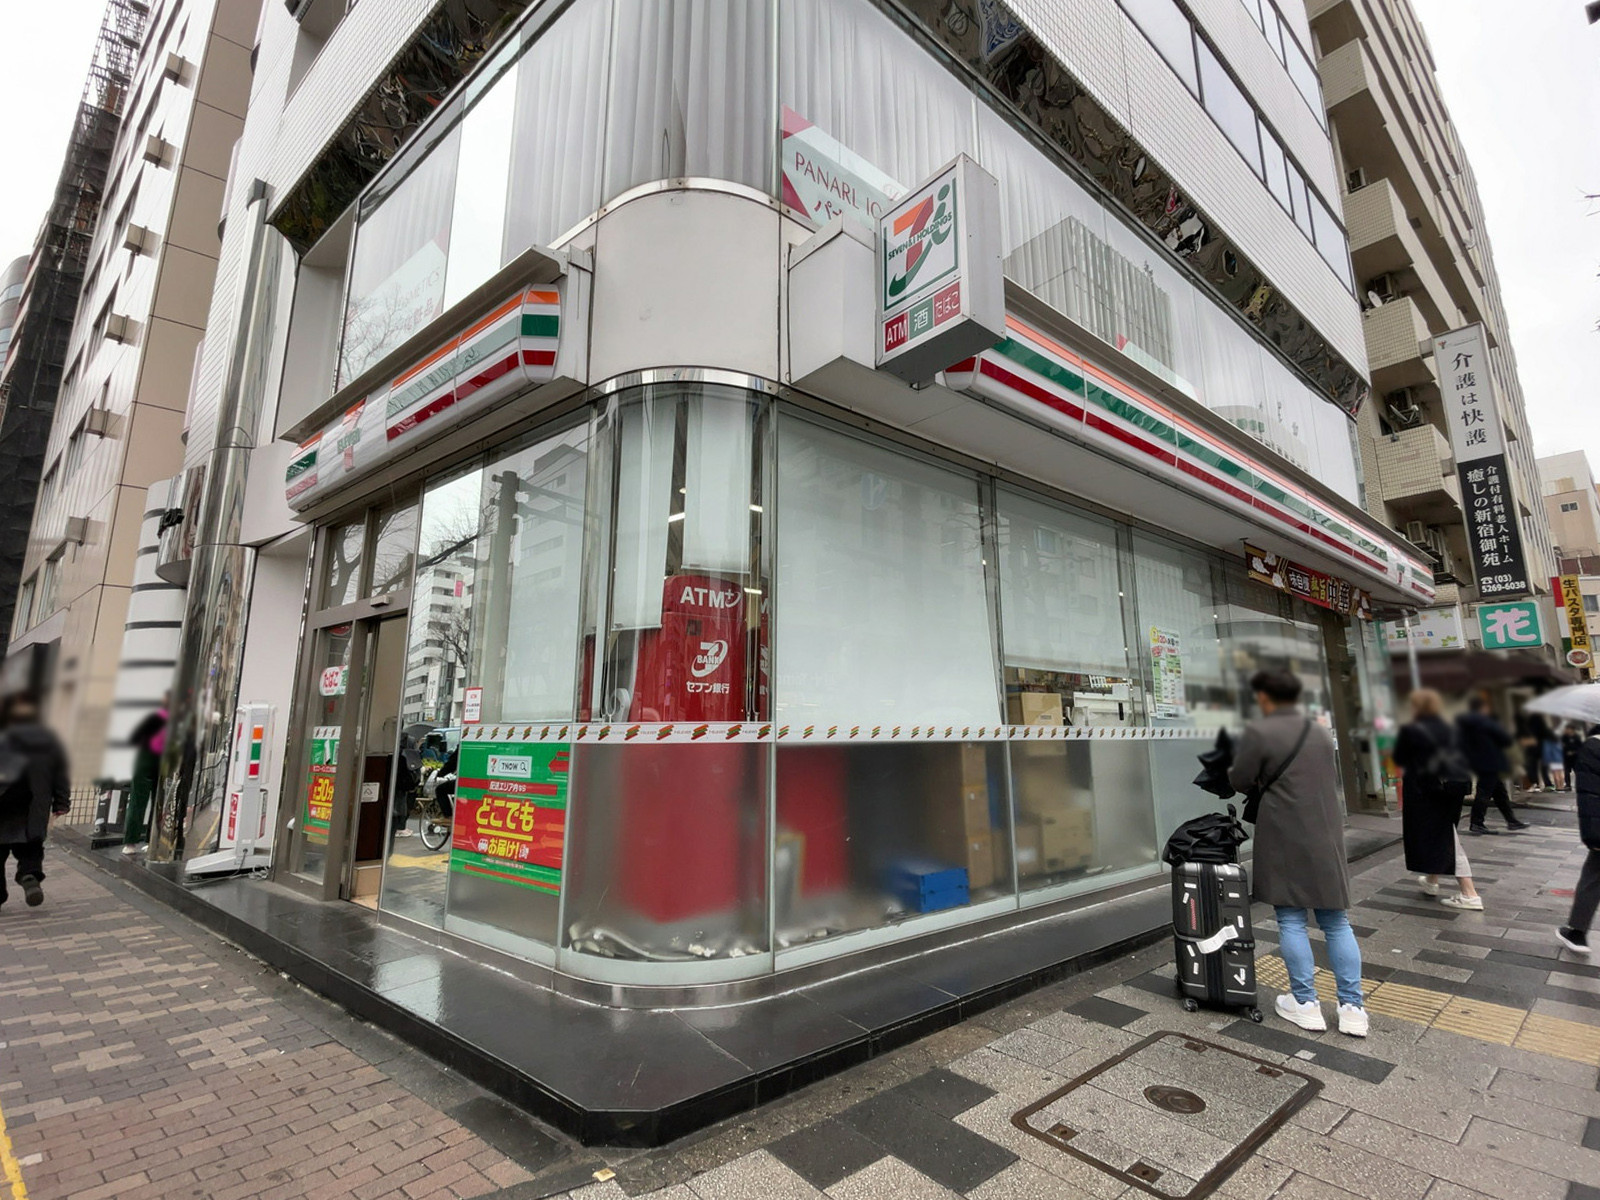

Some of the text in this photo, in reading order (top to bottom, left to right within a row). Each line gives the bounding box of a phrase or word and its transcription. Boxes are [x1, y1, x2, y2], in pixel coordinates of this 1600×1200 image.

[935, 290, 960, 317] たばこ
[886, 319, 908, 346] ATM
[914, 307, 929, 332] 酒
[1452, 352, 1487, 447] 介護は快護
[1466, 468, 1501, 568] 癒しの新宿御苑
[1486, 465, 1514, 563] 介護付有料老人ホーム
[1481, 581, 1527, 593] 5269-6038
[1494, 574, 1512, 584] (03)
[1485, 607, 1537, 644] 花
[696, 654, 721, 665] BANK
[686, 681, 730, 694] セブン銀行
[476, 797, 535, 832] どこでも
